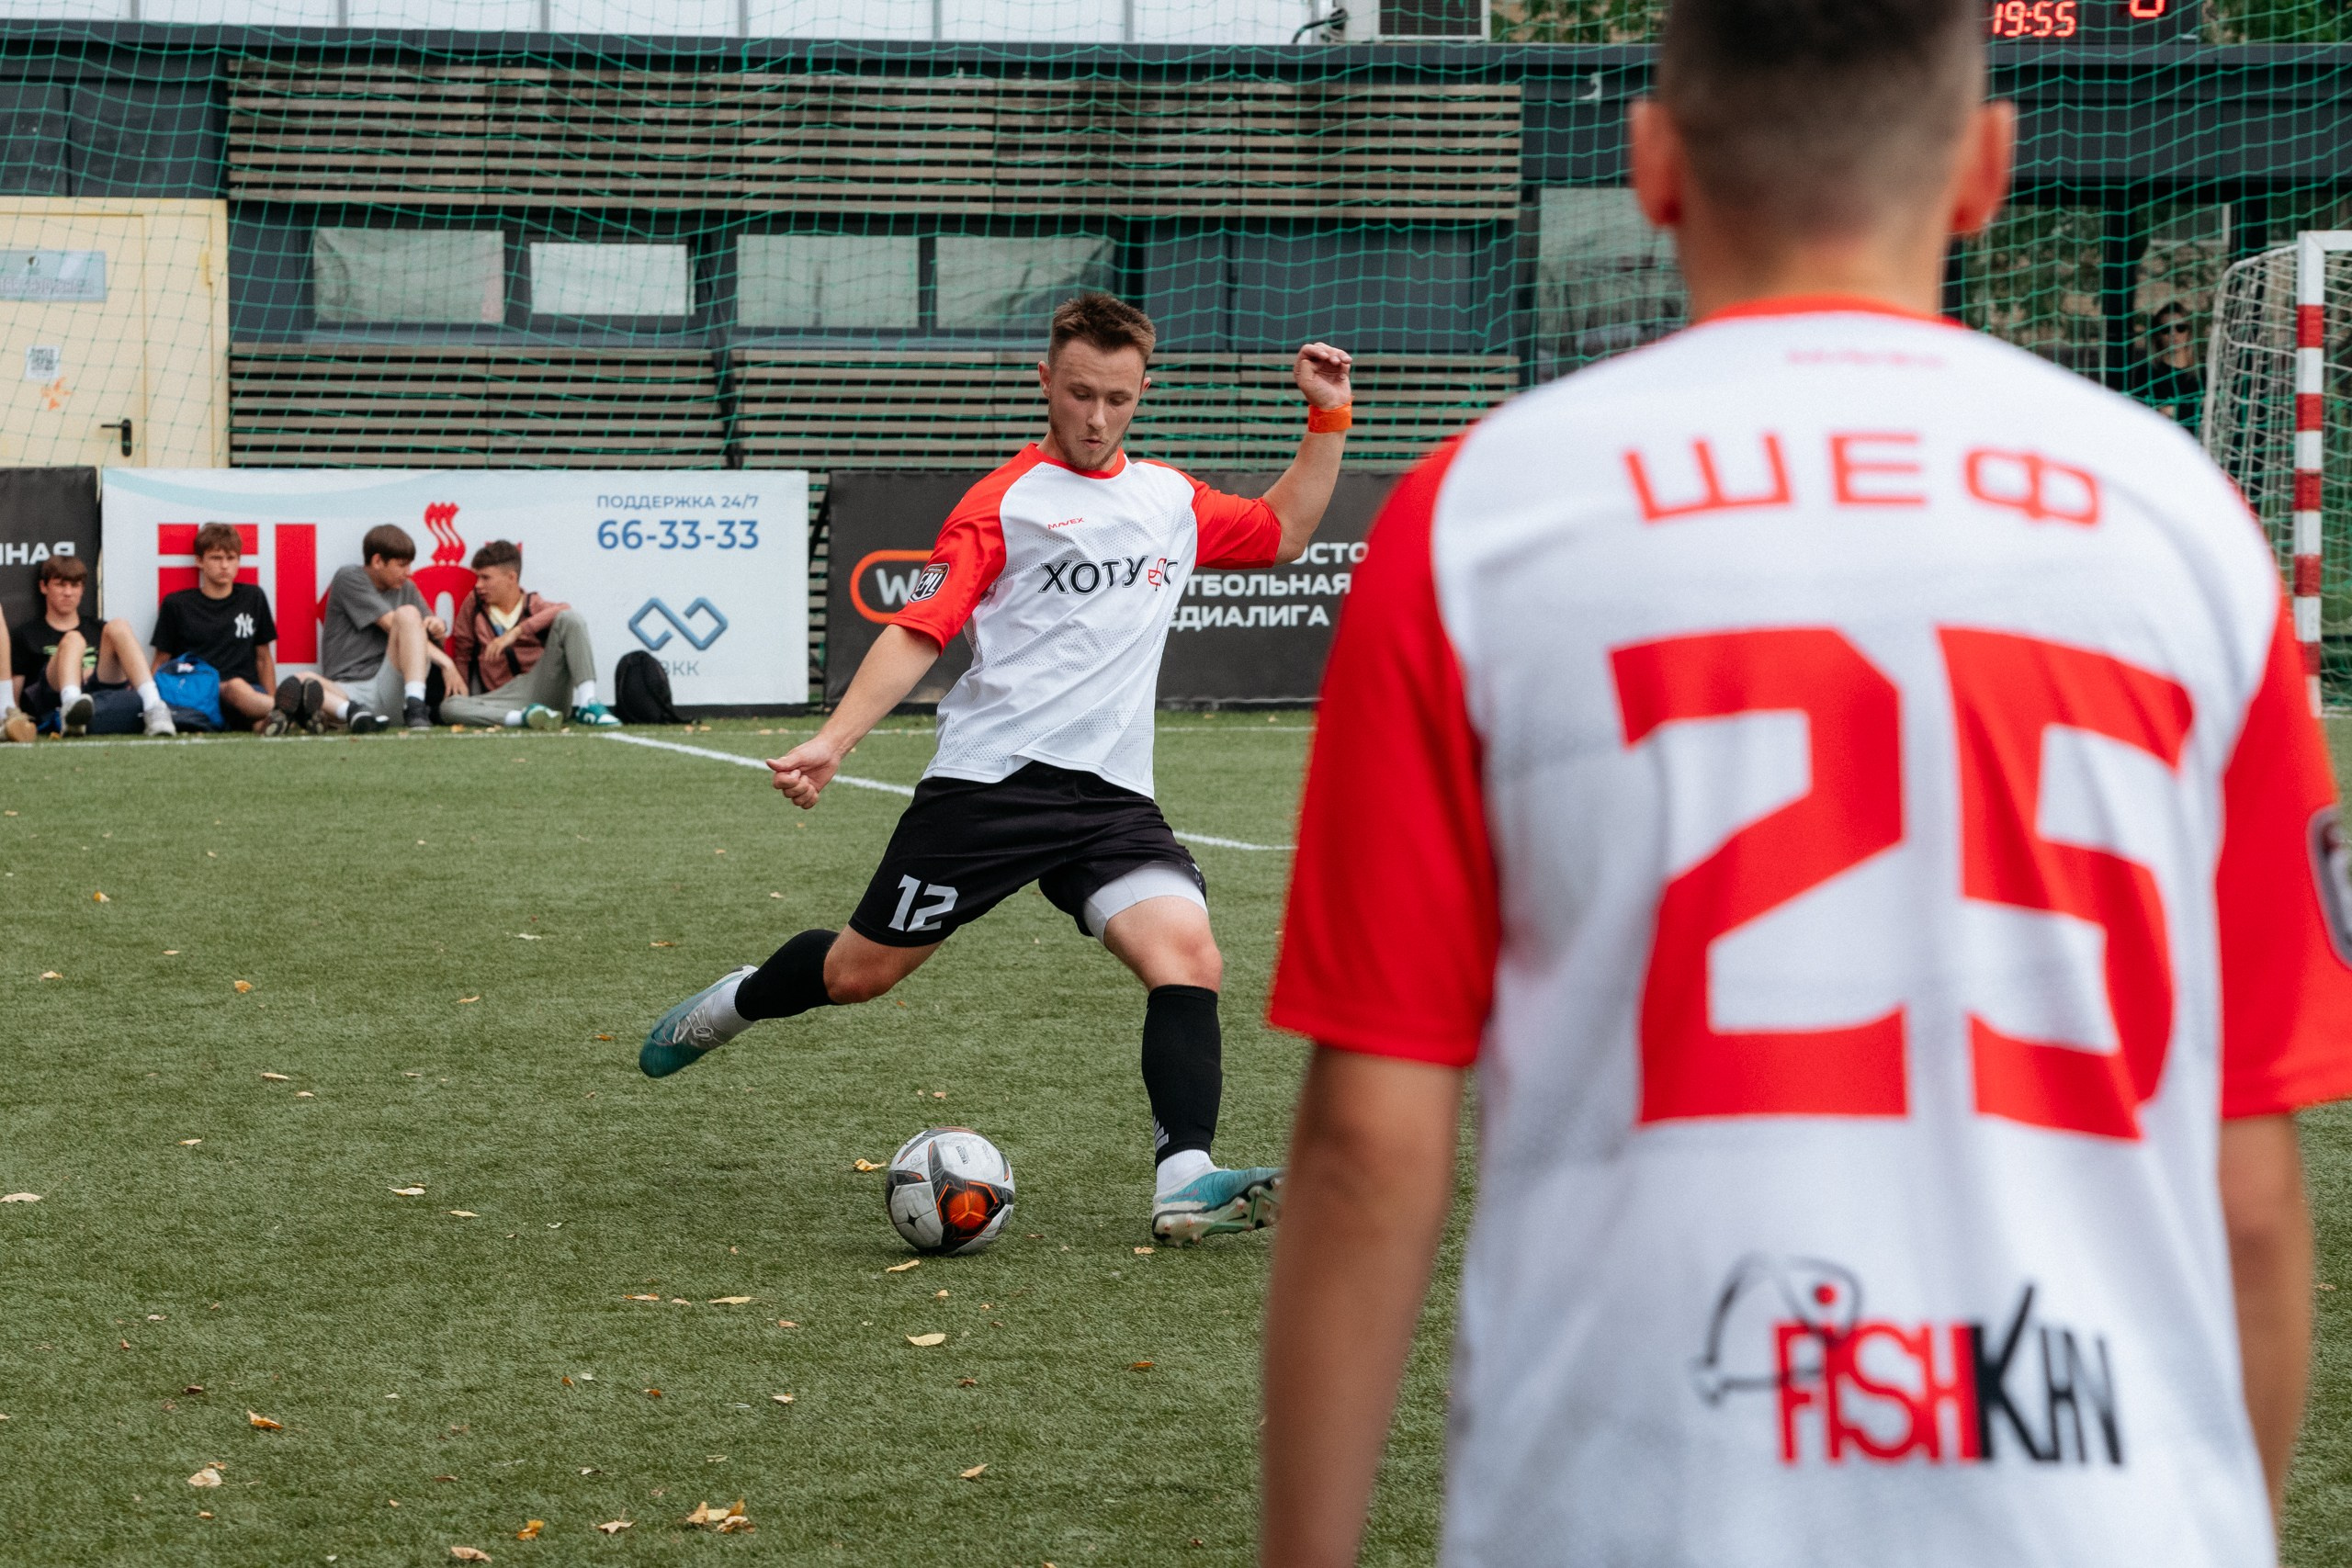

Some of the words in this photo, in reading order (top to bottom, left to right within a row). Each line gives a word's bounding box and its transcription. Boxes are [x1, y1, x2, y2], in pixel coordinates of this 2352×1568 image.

[1993, 1, 2075, 37] 19:55
[1623, 434, 2100, 525] ШЕФ
[597, 495, 716, 510] ПОДДЕРЖКА
[722, 494, 759, 509] 24/7
[0, 540, 76, 566] НАЯ
[597, 520, 759, 550] 66-33-33
[1609, 624, 2194, 1143] 25
[888, 874, 959, 932] 12
